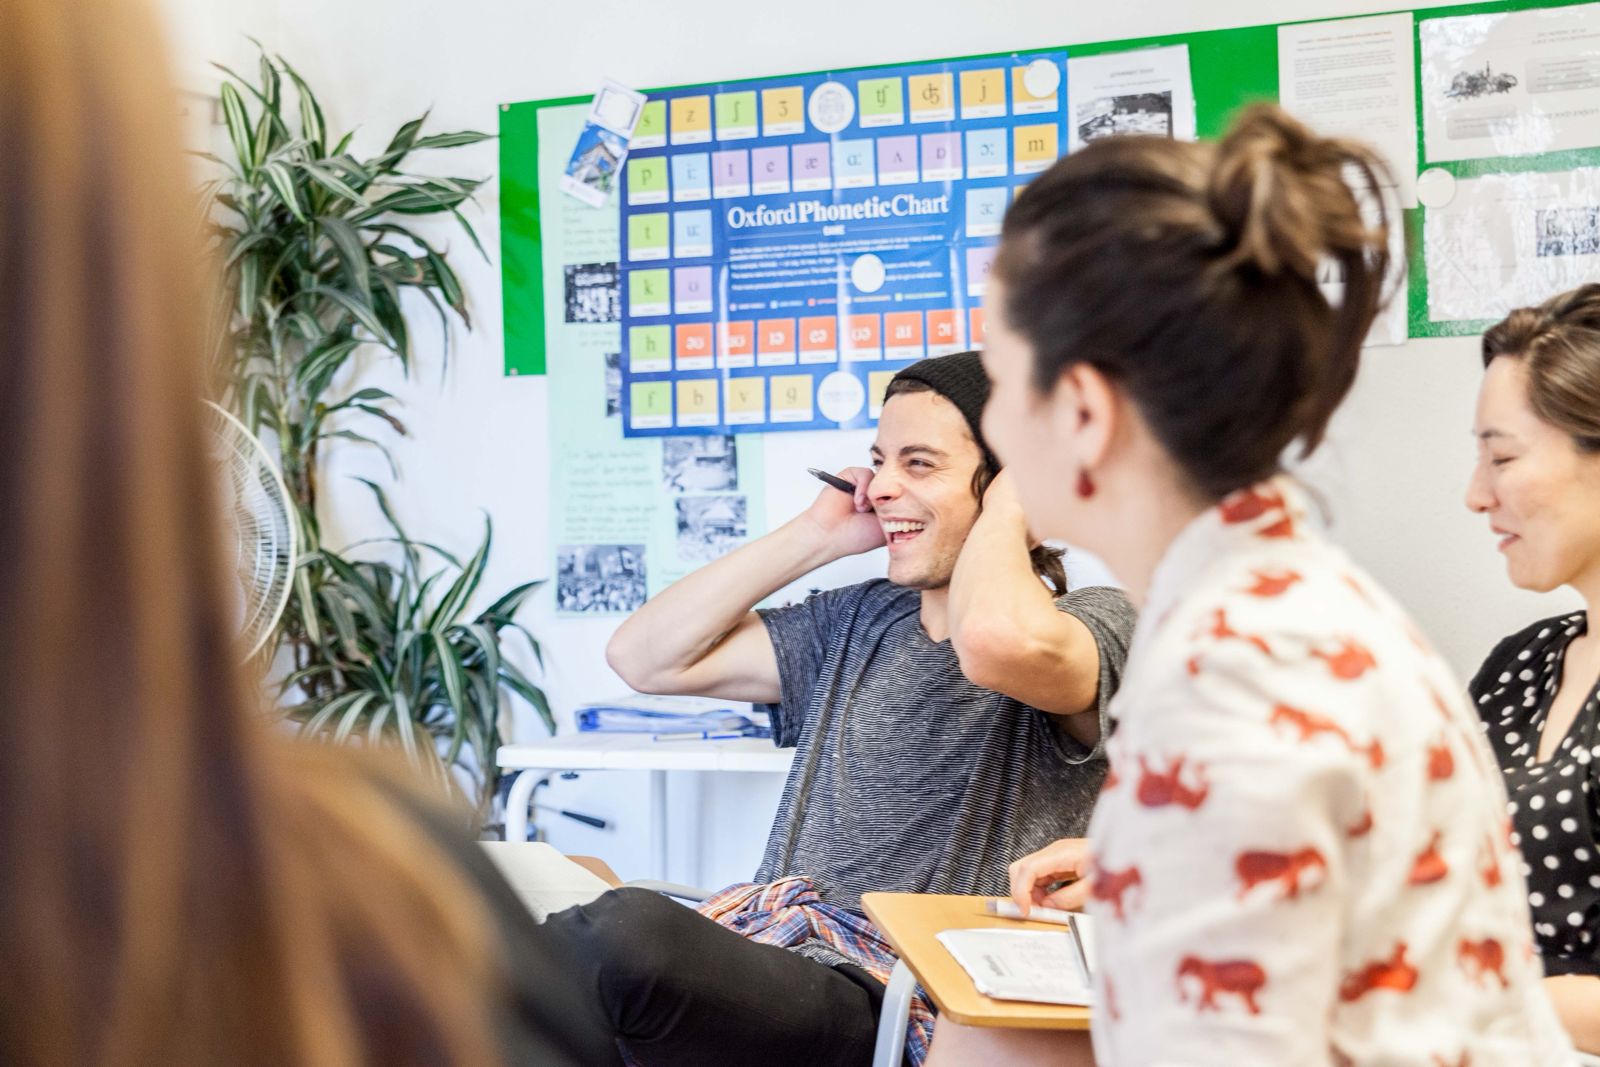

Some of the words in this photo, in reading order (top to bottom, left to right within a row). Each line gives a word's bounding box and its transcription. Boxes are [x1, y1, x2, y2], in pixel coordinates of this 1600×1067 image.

[1028, 139, 1044, 152] m
[728, 203, 796, 229] Oxford
[798, 196, 891, 223] Phonetic
[891, 194, 949, 217] Chart
